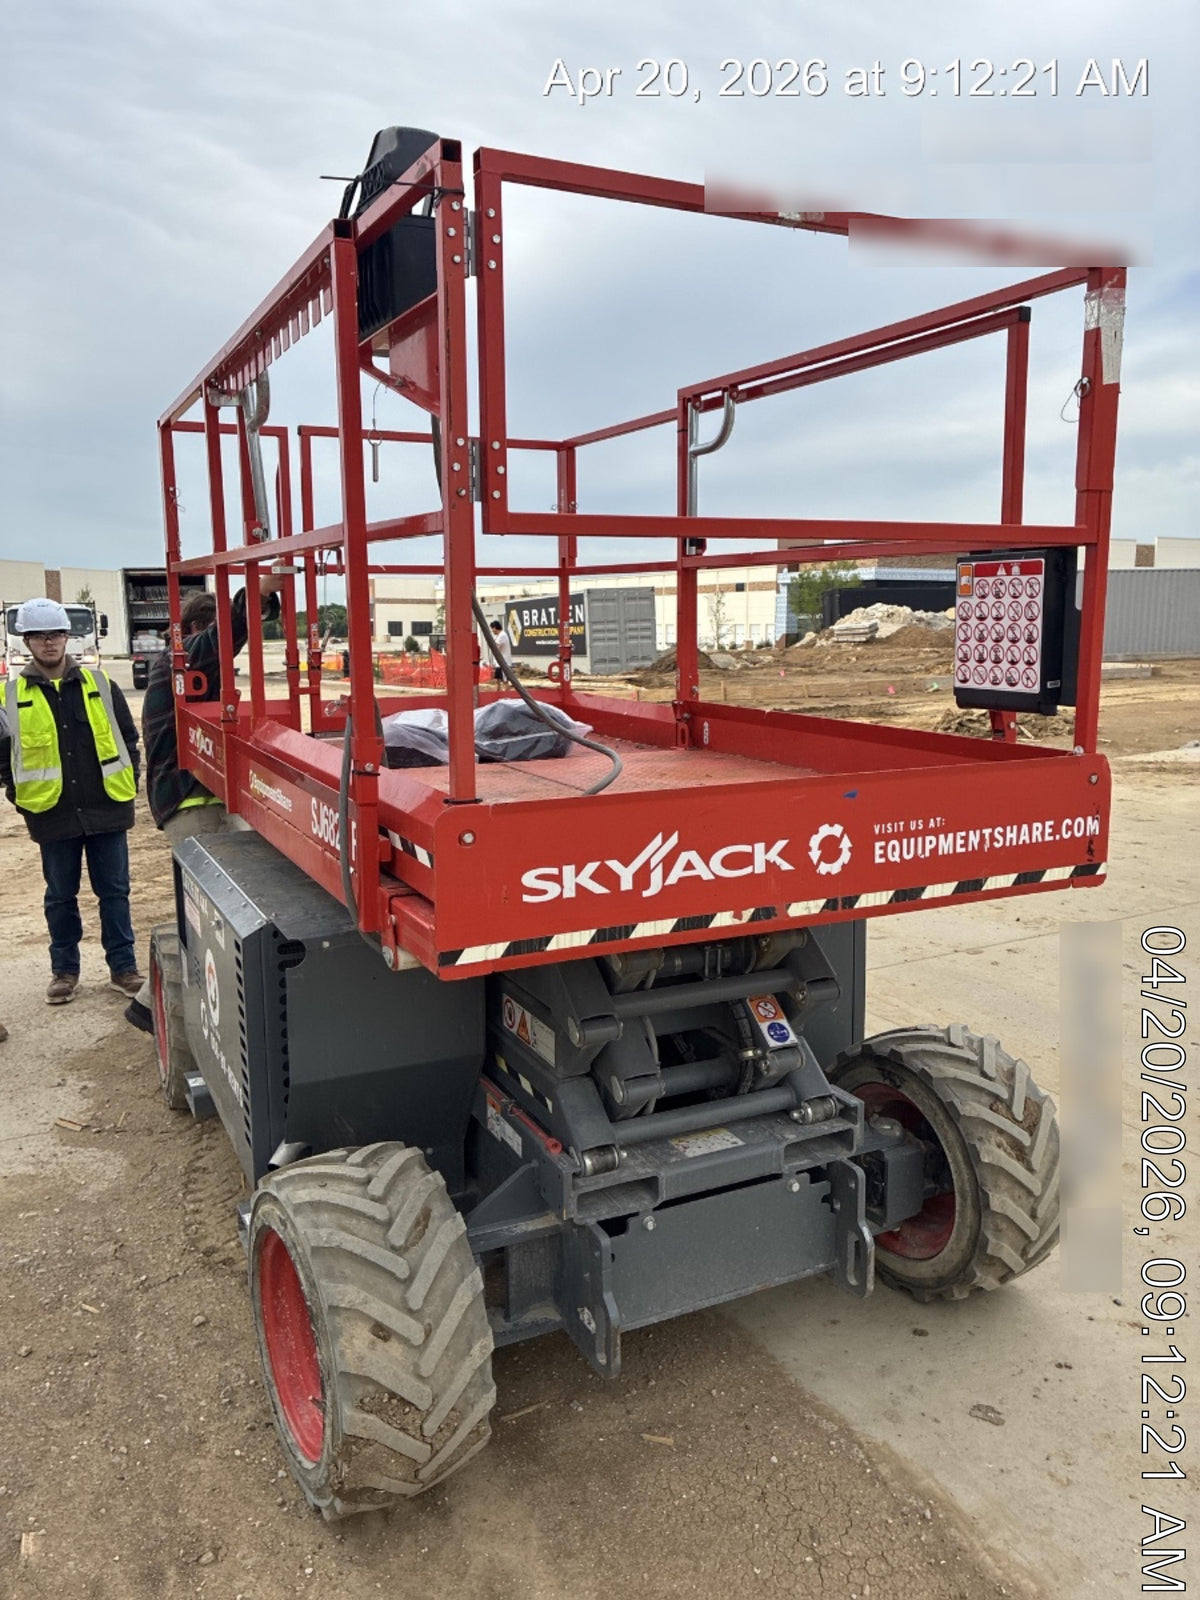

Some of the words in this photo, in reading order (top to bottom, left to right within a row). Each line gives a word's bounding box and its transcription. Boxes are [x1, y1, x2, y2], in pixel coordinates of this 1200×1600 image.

[873, 821, 904, 835] VISIT
[910, 819, 924, 831] US
[928, 817, 946, 829] AT:
[874, 815, 1100, 863] EQUIPMENTSHARE.COM
[521, 830, 795, 904] SKYJACK
